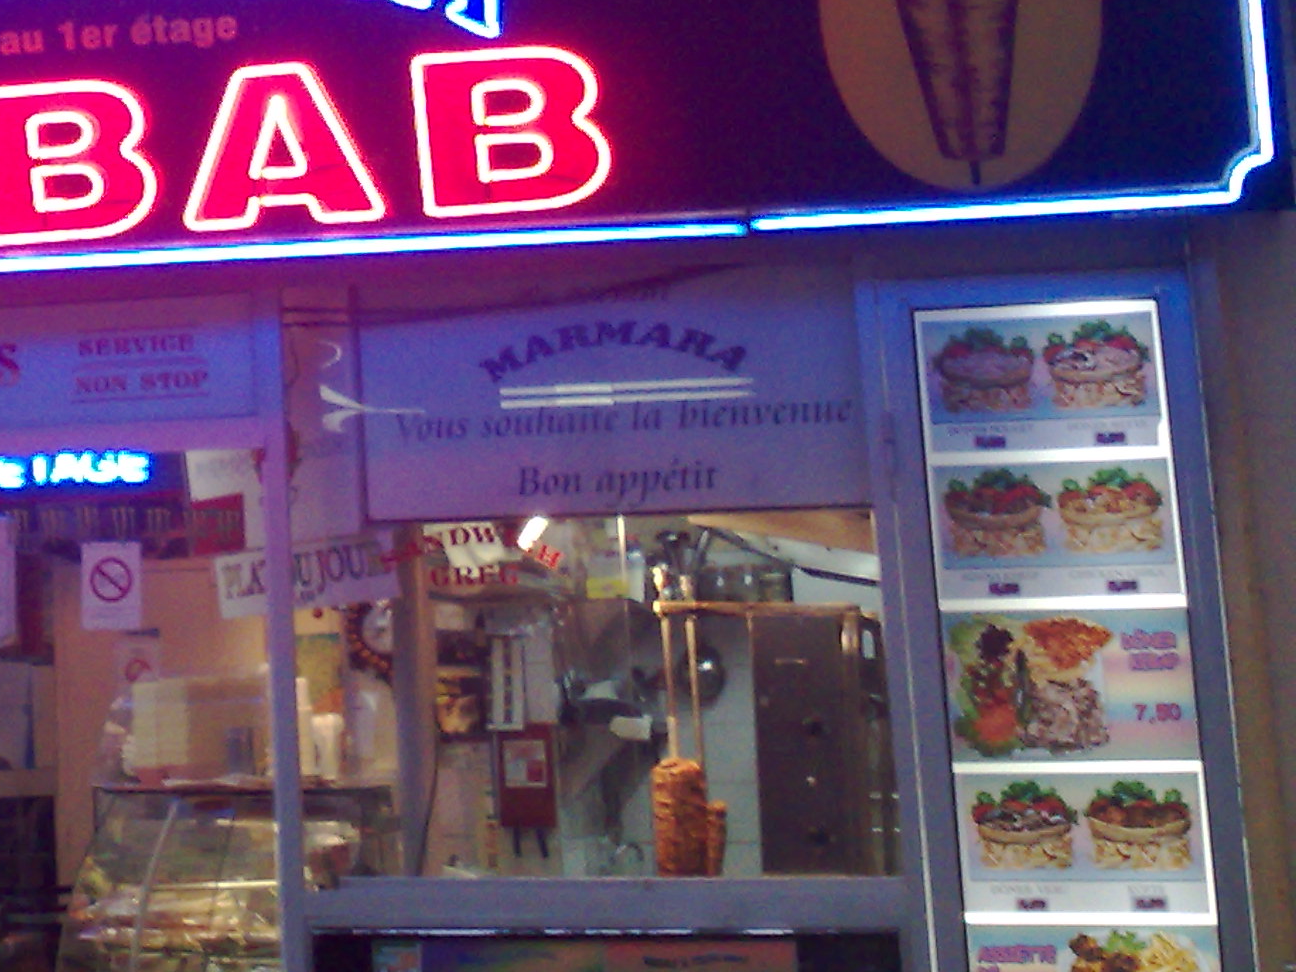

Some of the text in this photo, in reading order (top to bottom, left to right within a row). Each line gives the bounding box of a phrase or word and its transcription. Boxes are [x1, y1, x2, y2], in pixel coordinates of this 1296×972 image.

[58, 21, 119, 51] 1er
[129, 12, 239, 49] étage
[77, 333, 195, 357] SERVICE
[479, 320, 748, 385] MARMARA
[74, 370, 208, 395] NON STOP
[395, 413, 467, 442] Vous
[632, 402, 663, 431] la
[677, 396, 853, 431] bienvenue
[518, 458, 718, 508] Bon appétit
